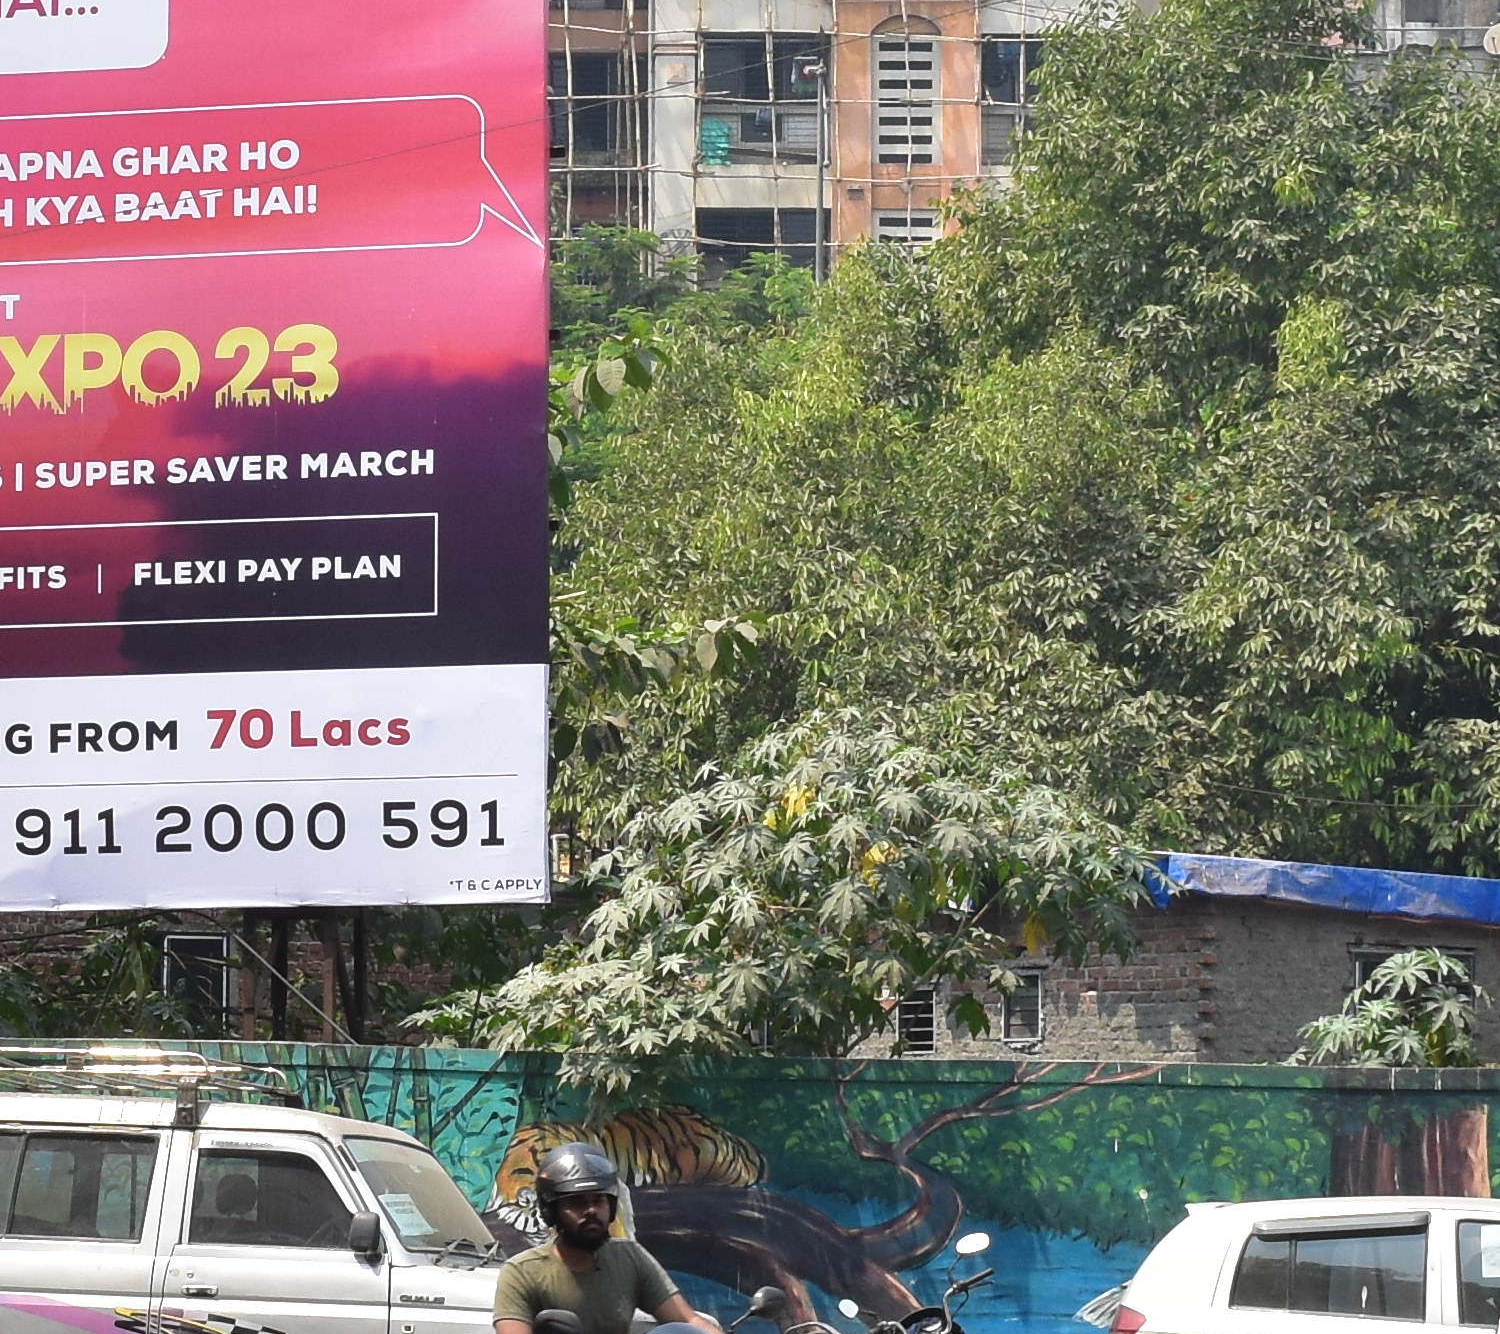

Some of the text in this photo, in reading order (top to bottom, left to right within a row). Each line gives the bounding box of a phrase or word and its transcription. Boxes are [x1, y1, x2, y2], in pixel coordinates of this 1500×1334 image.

[111, 142, 228, 178] GHAR
[239, 139, 300, 173] HO
[26, 194, 105, 226] KYA
[114, 188, 224, 222] BAAT
[233, 183, 318, 218] HAI!
[213, 322, 340, 411] 23
[34, 456, 158, 490] SUPER
[165, 452, 290, 486] SAVER
[299, 447, 437, 481] MARCH
[133, 556, 228, 588] FLEXI
[237, 554, 301, 584] PAY
[309, 551, 403, 583] PLAN
[48, 720, 180, 755] FROM
[206, 709, 274, 751] 70
[291, 706, 413, 749] Lacs
[15, 807, 121, 857] 911
[155, 803, 348, 853] 2000
[381, 798, 505, 848] 591
[494, 878, 542, 891] APPLY
[399, 1294, 446, 1305] QUALIS
